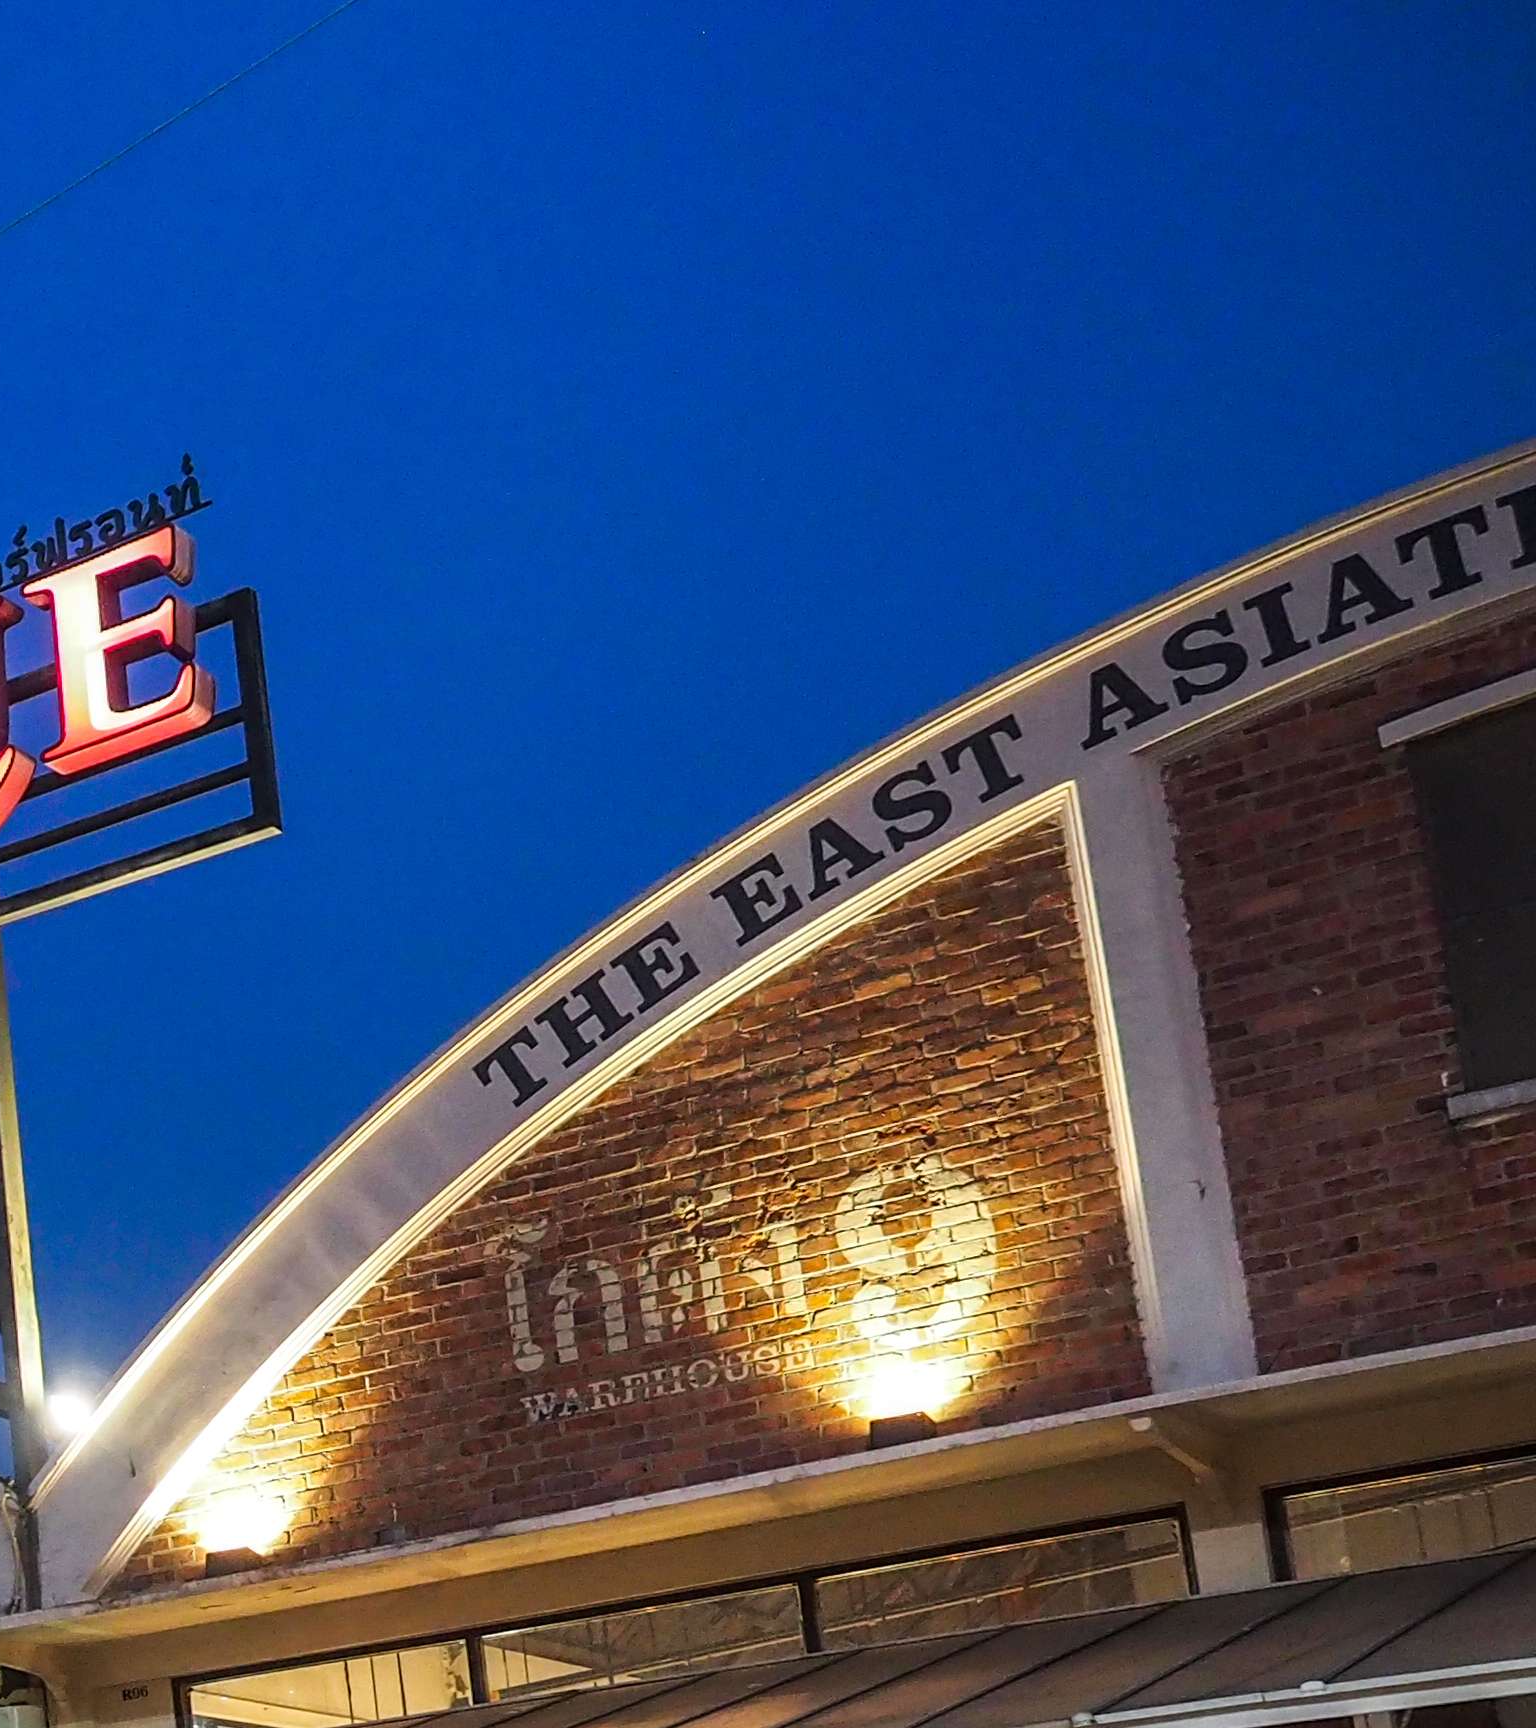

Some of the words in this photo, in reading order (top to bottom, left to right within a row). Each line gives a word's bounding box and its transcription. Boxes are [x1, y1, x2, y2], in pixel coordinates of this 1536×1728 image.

[472, 919, 701, 1109] THE
[709, 714, 1023, 947] EAST
[834, 1152, 1001, 1349] 9
[519, 1338, 816, 1424] WAREHOUSE
